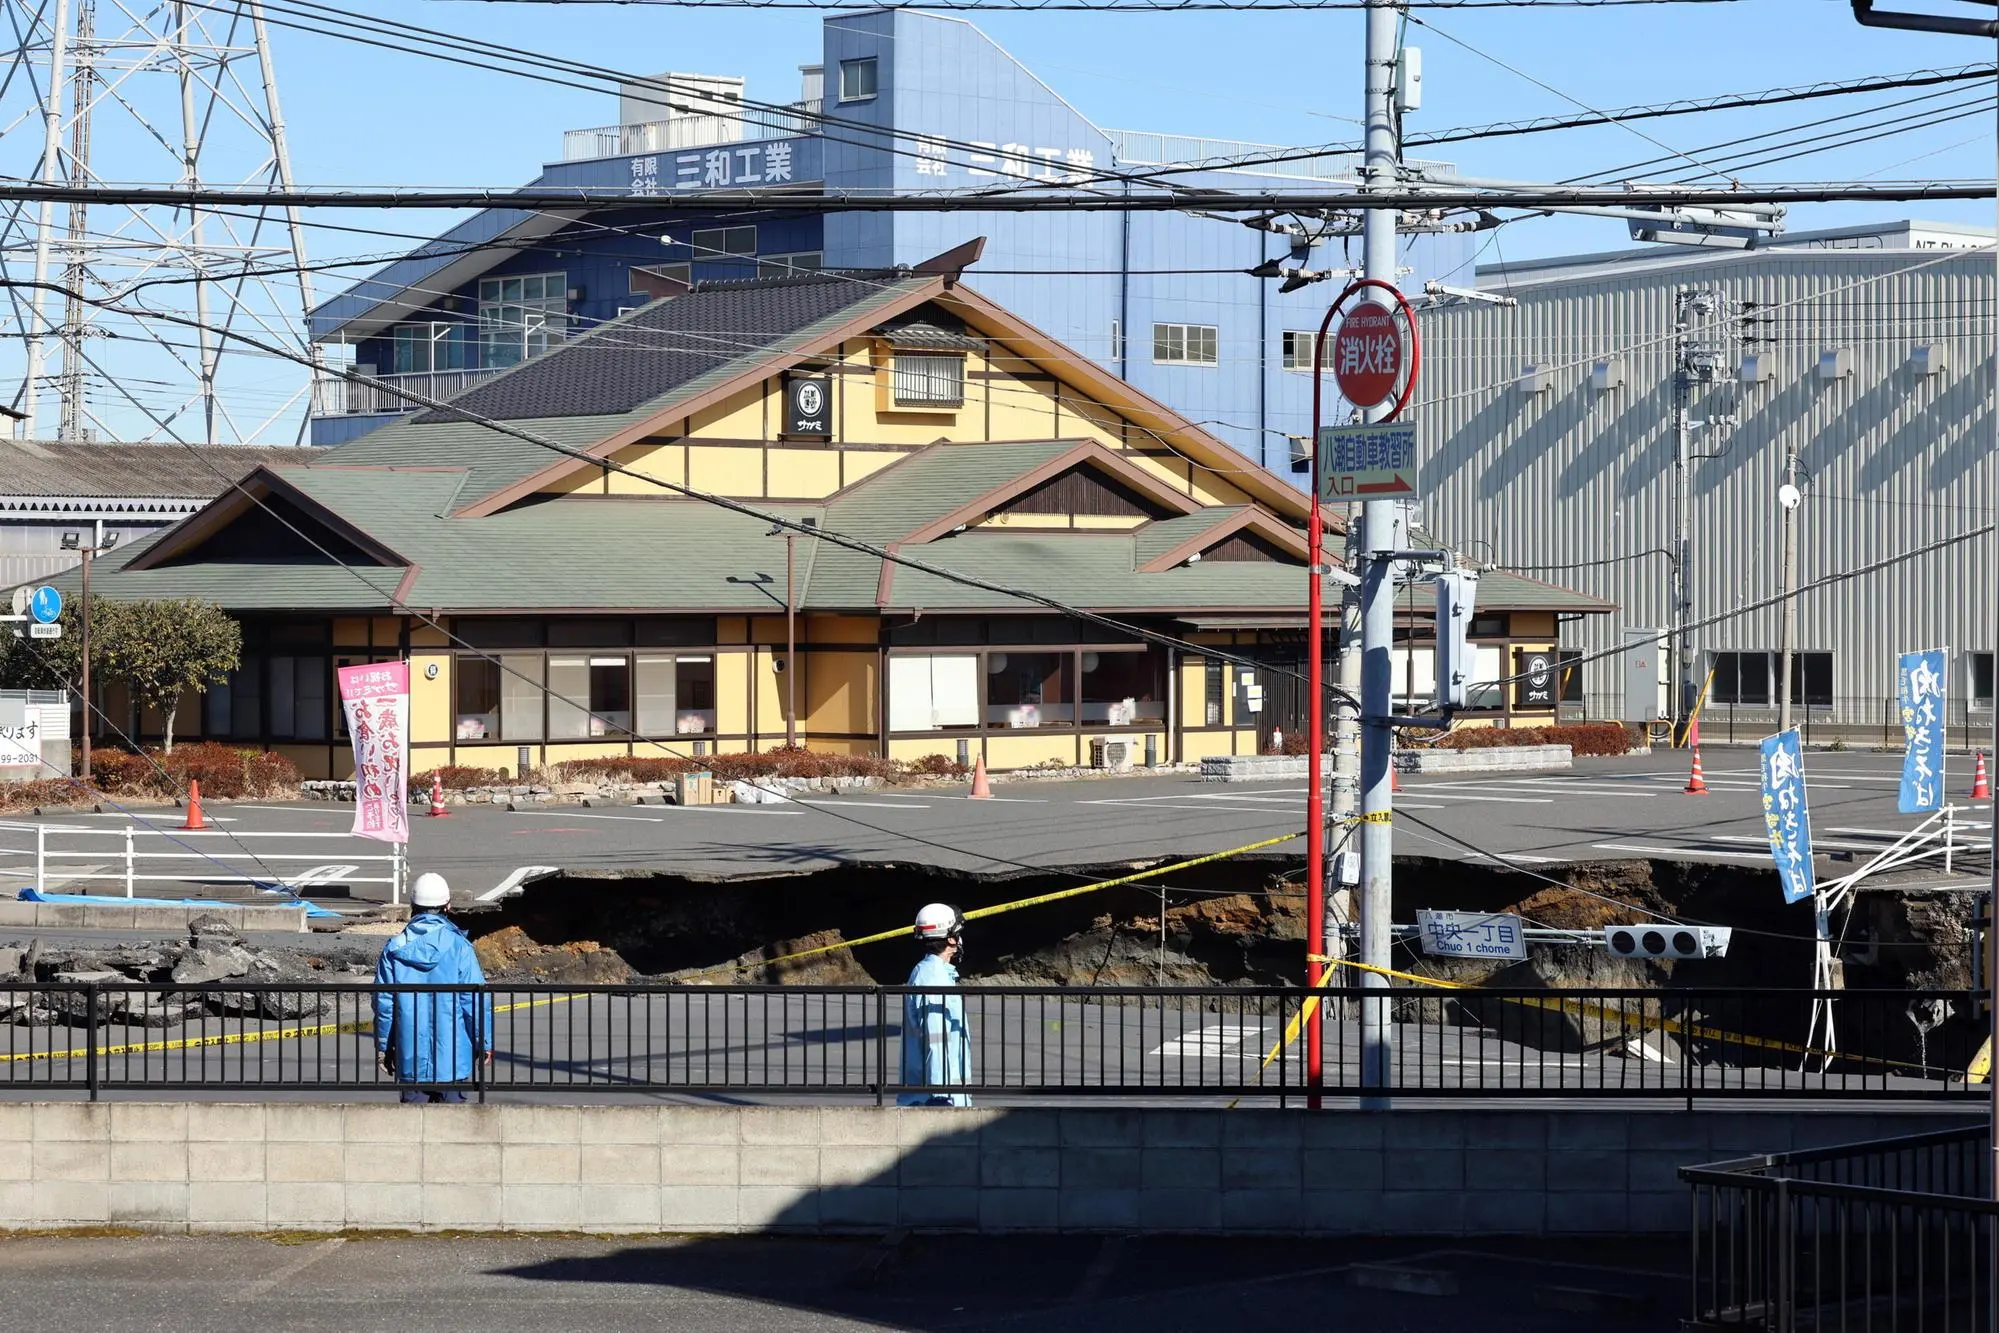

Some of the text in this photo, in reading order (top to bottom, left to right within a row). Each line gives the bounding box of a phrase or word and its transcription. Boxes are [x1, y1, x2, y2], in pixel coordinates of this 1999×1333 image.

[631, 157, 658, 178] 有限
[676, 142, 792, 189] 三和工業
[916, 154, 947, 176] 会社
[968, 141, 1094, 188] 三和工業
[631, 178, 658, 197] 会社
[1346, 316, 1390, 328] FIRE HYDRANT
[1341, 334, 1396, 375] 消火栓
[797, 419, 822, 431] サガミ
[1324, 431, 1413, 472] 八潮自動車教習所
[1327, 476, 1354, 496] 入口
[1428, 921, 1514, 943] 中央一丁目
[1436, 940, 1510, 954] Chuo 1 chome
